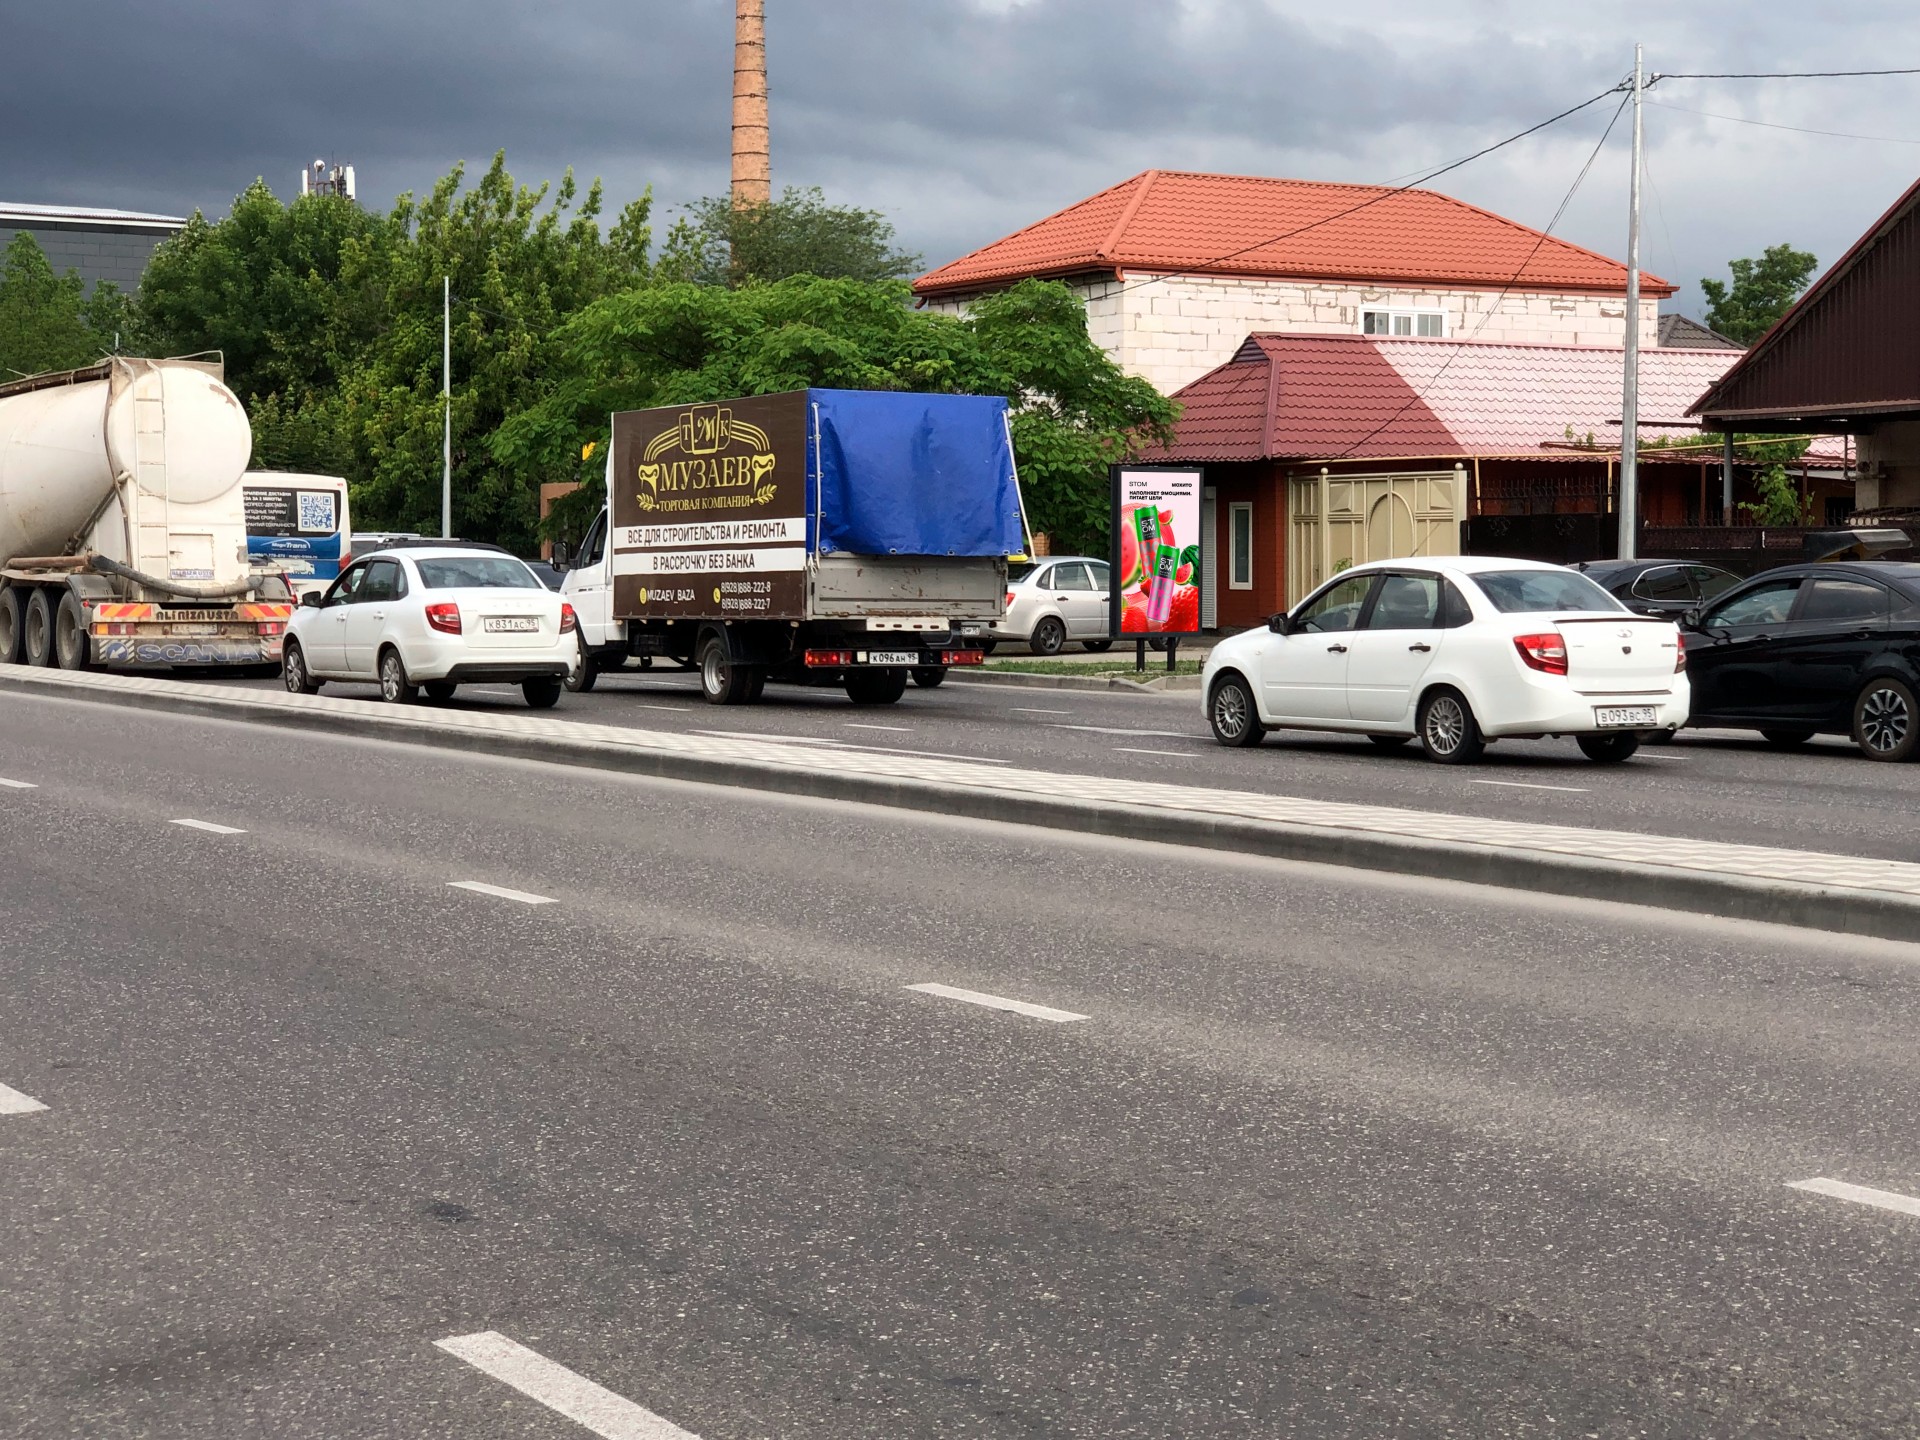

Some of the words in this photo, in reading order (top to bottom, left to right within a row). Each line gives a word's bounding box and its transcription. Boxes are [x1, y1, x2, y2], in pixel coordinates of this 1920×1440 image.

[660, 455, 752, 492] МУЗАЕВ
[659, 499, 701, 513] ТОРГОВАЯ
[701, 494, 751, 510] КОМПАНИЯ
[628, 529, 643, 545] ВСЕ
[644, 528, 661, 546] ДЛЯ
[663, 524, 731, 543] СТРОИТЕЛЬСТВА
[733, 524, 740, 540] И
[742, 522, 787, 540] РЕМОНТА
[653, 556, 658, 571] В
[660, 555, 707, 570] РАССРОЧКУ
[709, 554, 724, 569] БЕЗ
[725, 553, 755, 568] БАНКА
[646, 588, 696, 605] MUZAEV_BAZA
[206, 610, 239, 620] USTA
[136, 644, 261, 662] SCANIA
